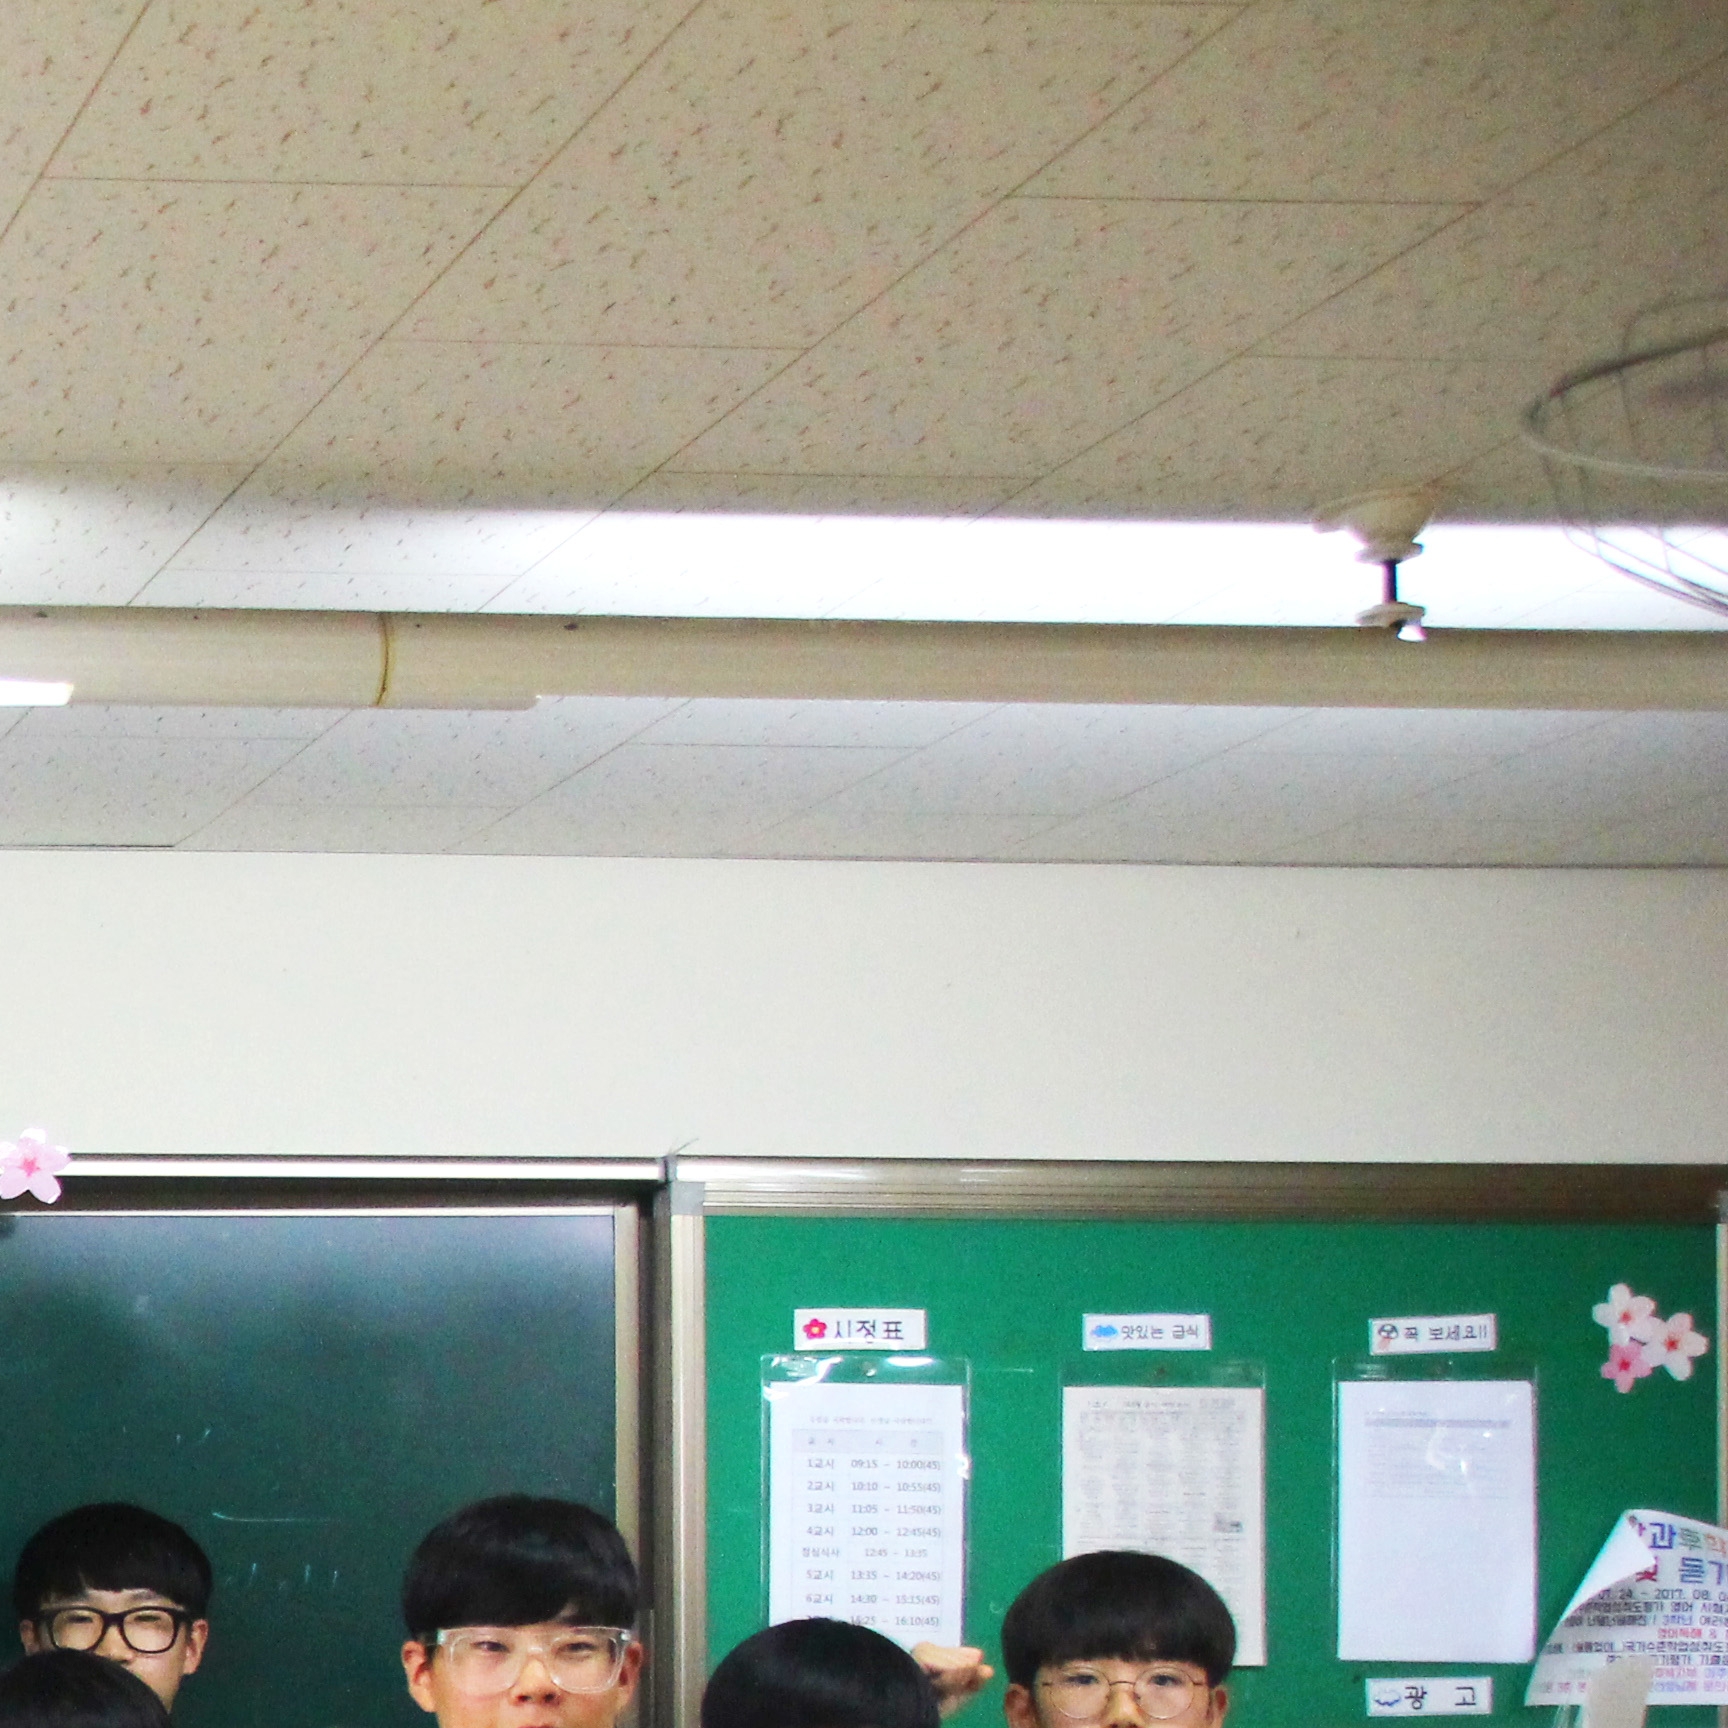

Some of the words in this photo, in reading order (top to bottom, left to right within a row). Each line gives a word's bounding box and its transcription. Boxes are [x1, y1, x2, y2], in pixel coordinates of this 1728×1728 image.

[834, 1319, 905, 1344] 시정표
[1121, 1325, 1164, 1340] 맛있는
[1172, 1324, 1199, 1340] 급식
[1404, 1326, 1418, 1342] 꼭
[1671, 1601, 1694, 1613] 영어
